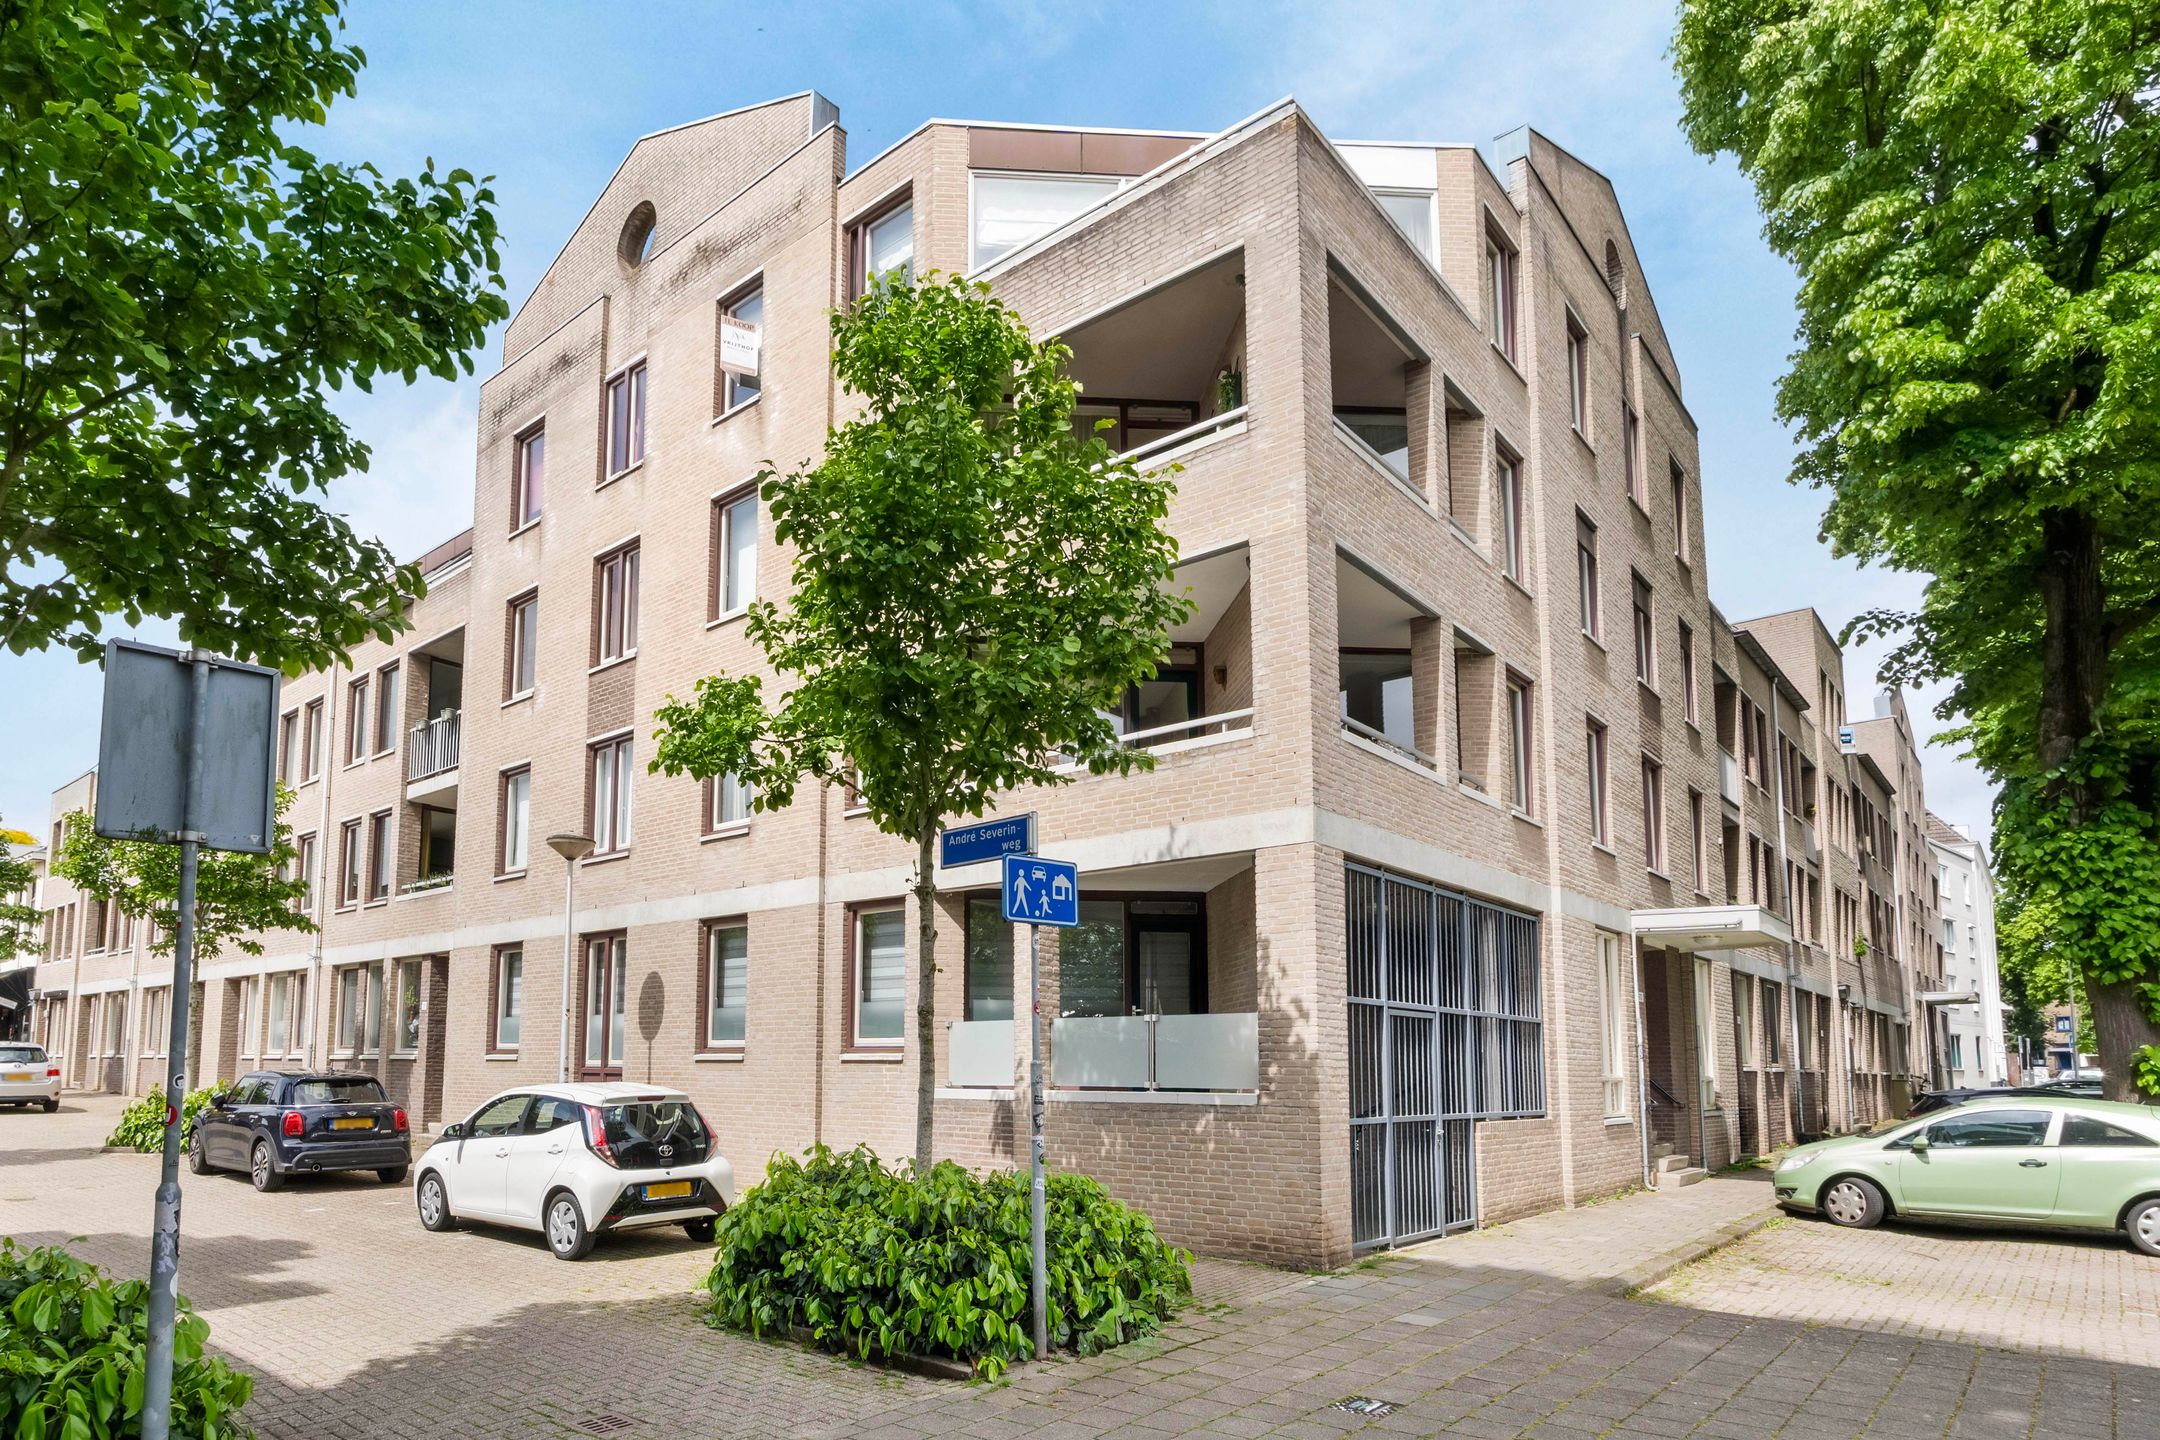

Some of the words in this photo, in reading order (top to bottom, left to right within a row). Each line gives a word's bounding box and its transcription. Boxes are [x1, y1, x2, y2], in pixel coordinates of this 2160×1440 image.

[724, 317, 733, 326] TE
[734, 319, 755, 331] KOOP
[949, 831, 977, 846] André
[979, 824, 1021, 840] Severin-
[1001, 839, 1021, 851] weg
